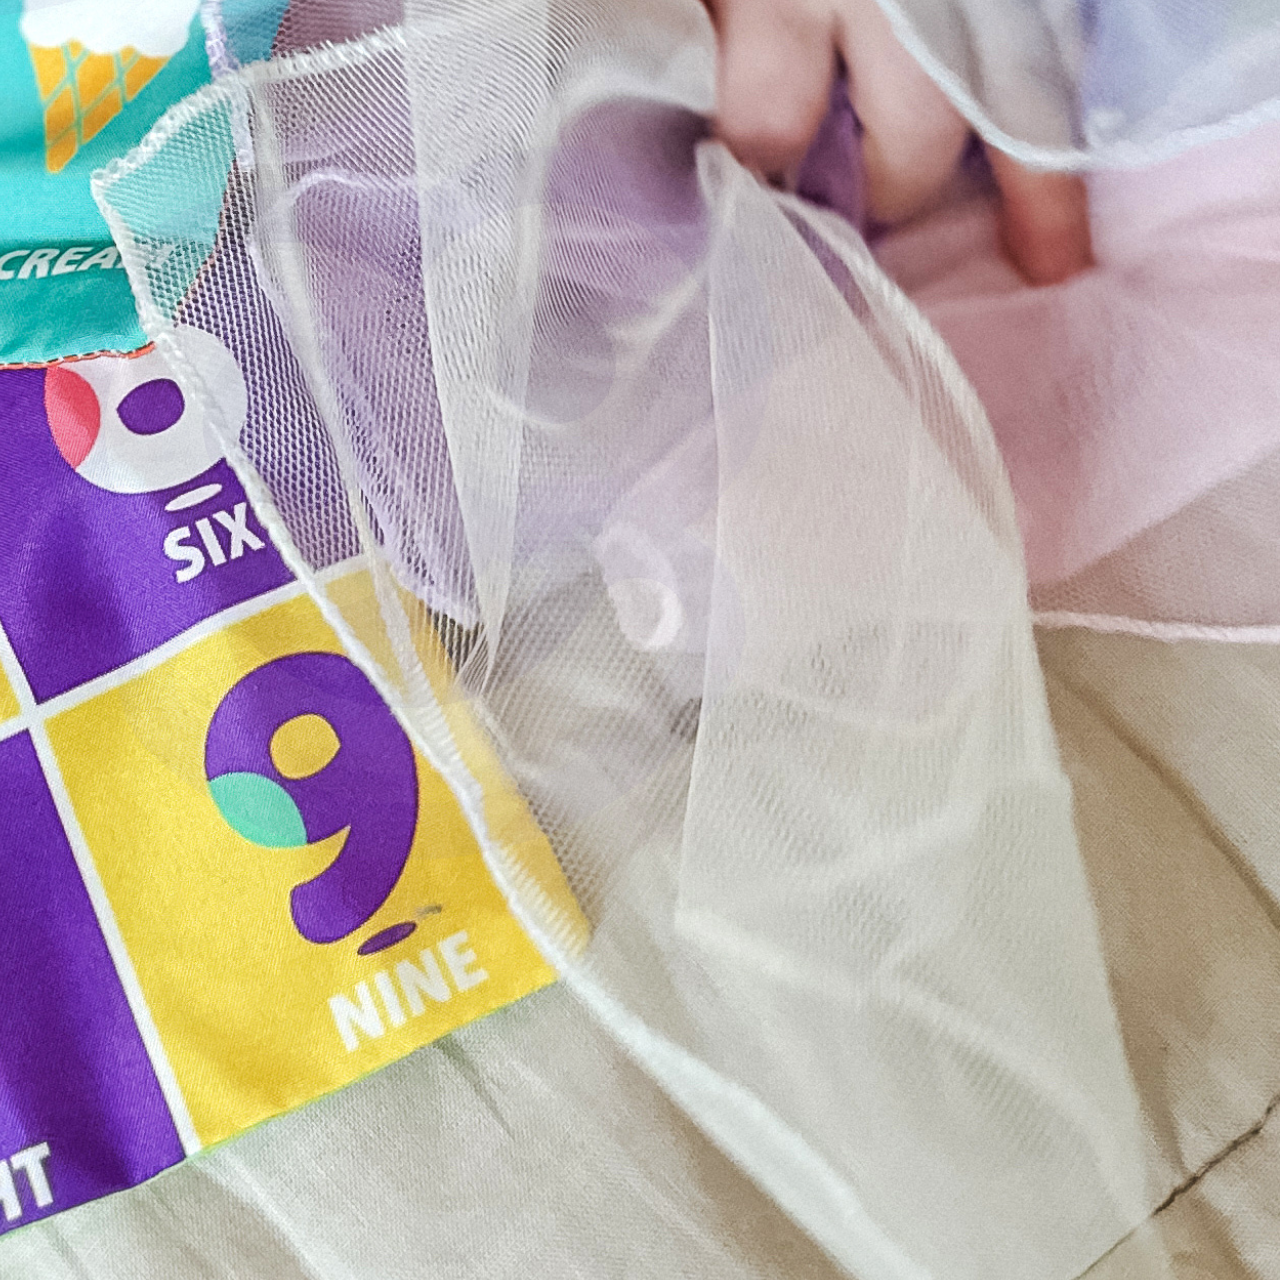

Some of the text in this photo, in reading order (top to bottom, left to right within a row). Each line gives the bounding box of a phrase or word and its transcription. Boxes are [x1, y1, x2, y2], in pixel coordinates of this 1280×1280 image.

[163, 502, 265, 583] SIX
[205, 652, 419, 944] 9
[327, 930, 489, 1052] NINE
